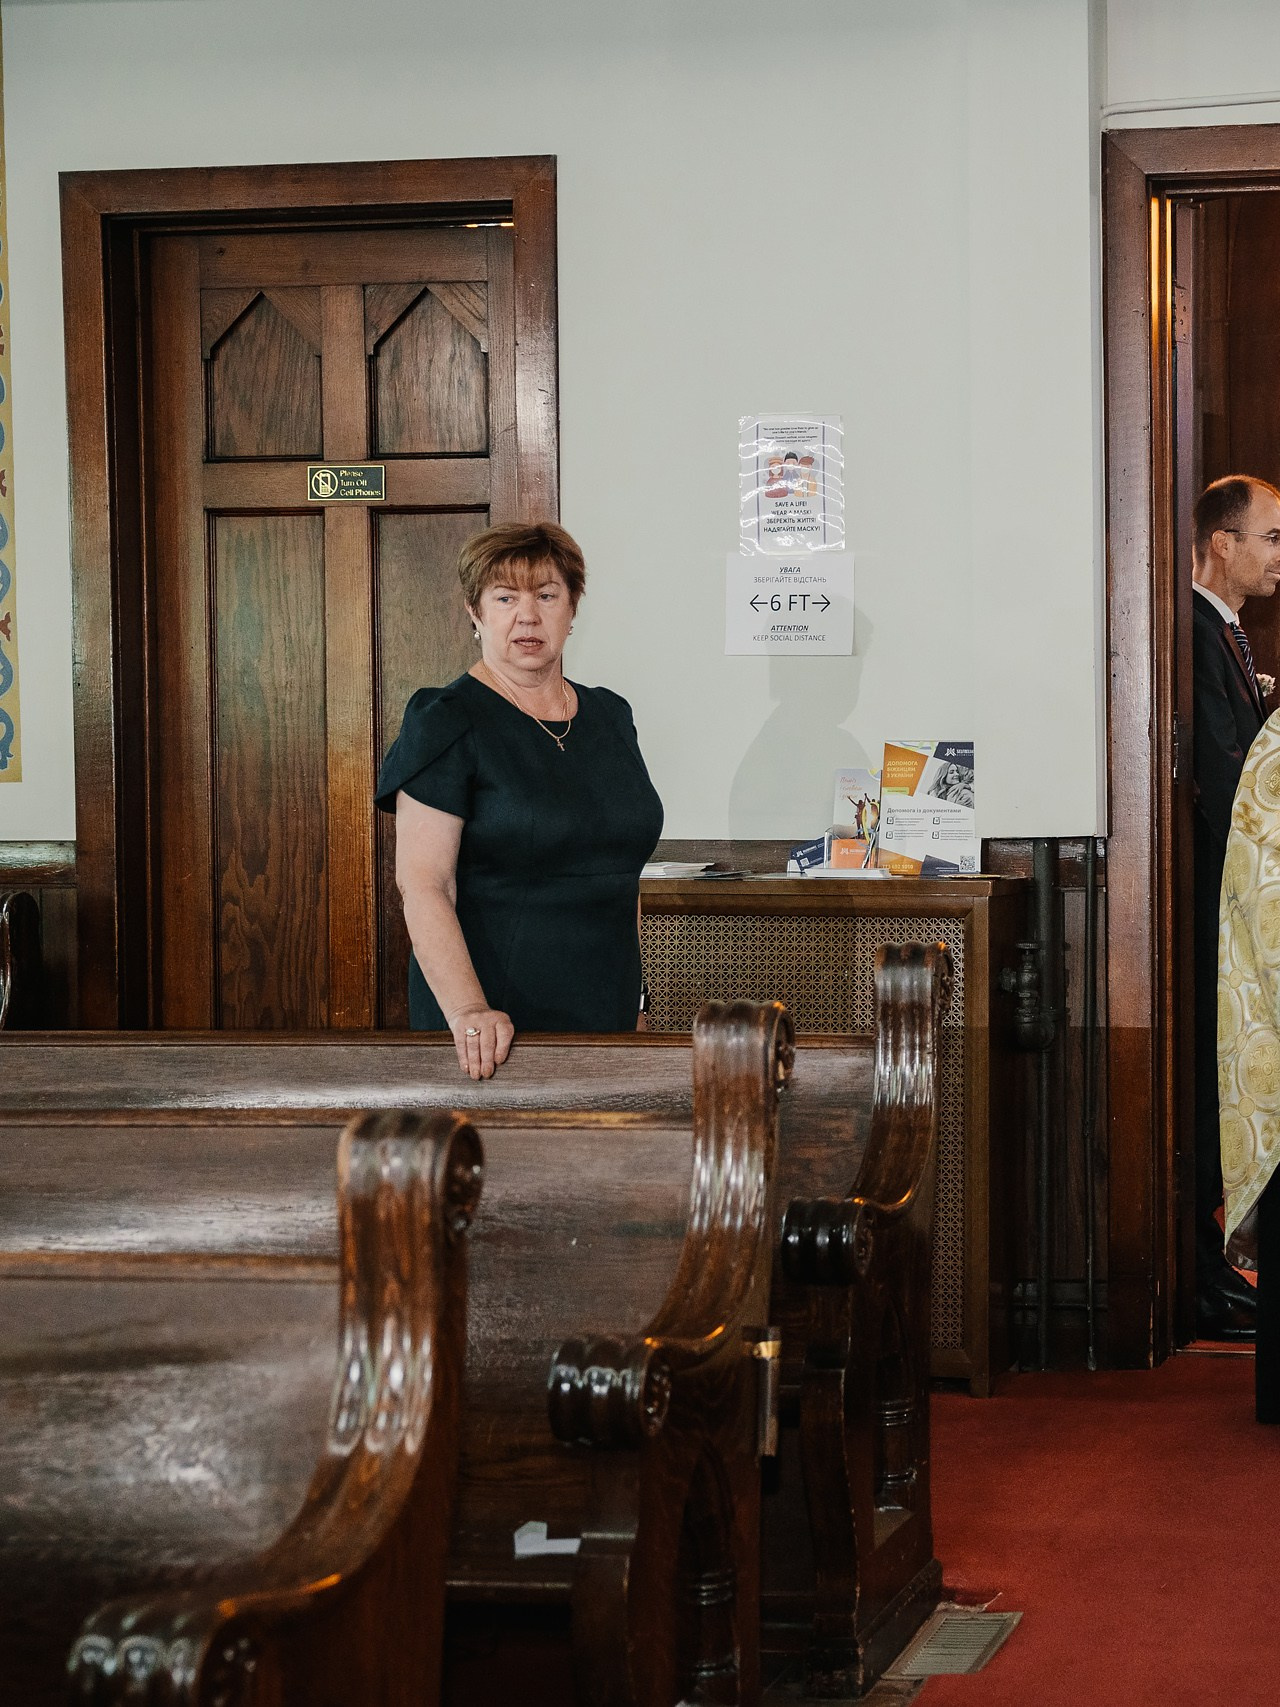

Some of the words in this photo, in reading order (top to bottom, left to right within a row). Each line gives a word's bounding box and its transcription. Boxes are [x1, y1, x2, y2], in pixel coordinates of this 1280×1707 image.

[793, 576, 827, 584] ВІДСТАНЬ
[770, 594, 781, 611] 6
[788, 594, 810, 611] FT
